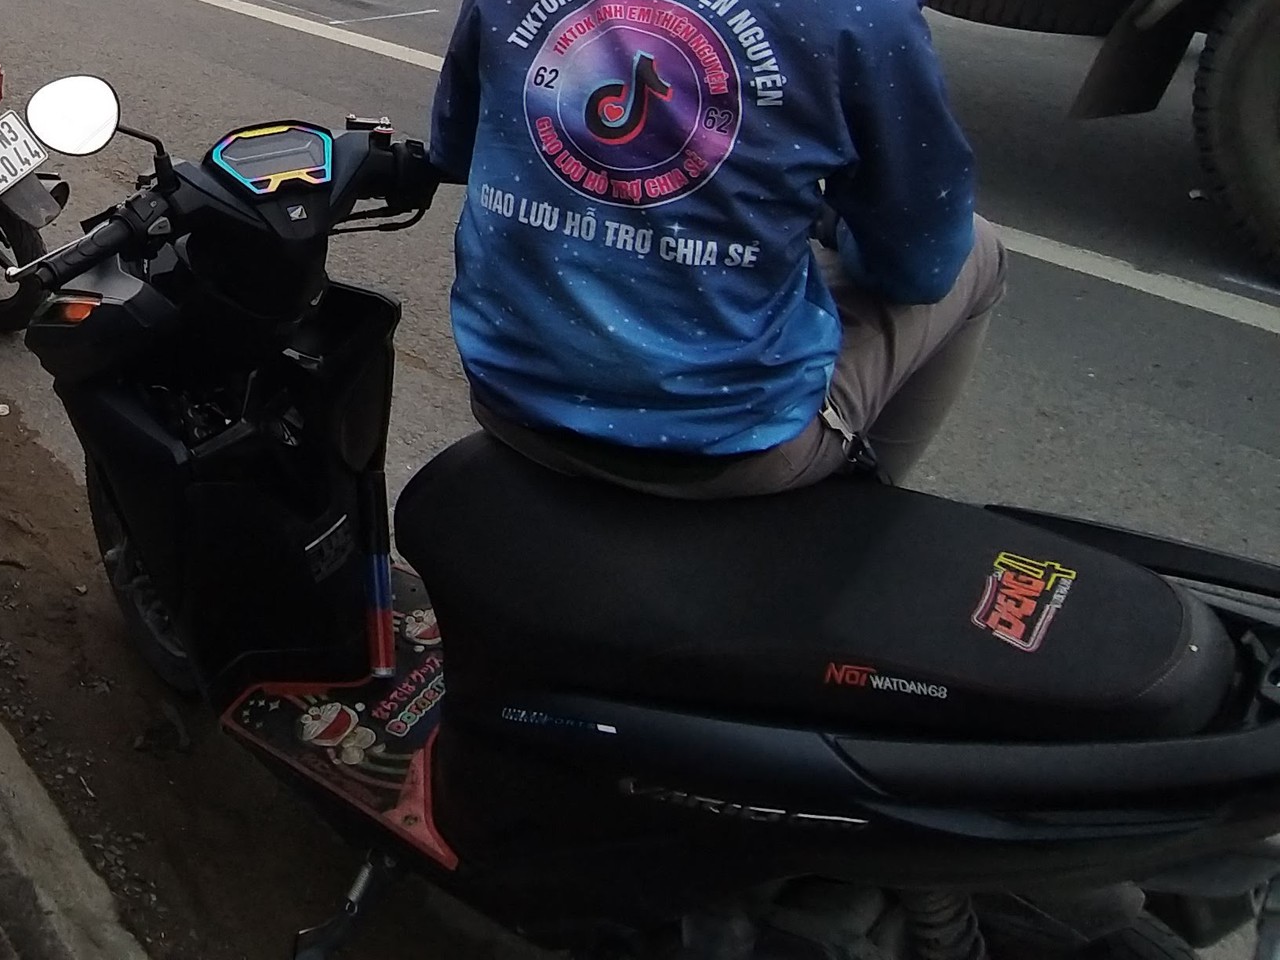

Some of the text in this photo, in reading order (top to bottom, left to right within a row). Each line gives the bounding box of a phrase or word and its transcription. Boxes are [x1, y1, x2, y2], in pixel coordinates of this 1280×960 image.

[532, 65, 560, 91] 62
[553, 4, 730, 96] TIKTOK ANH EM THIỆN NGUYỆN
[726, 8, 788, 107] NGUYỆN
[535, 115, 564, 156] GIAO
[643, 167, 689, 198] CHIA
[702, 106, 734, 136] 62
[480, 183, 515, 218] GIAO
[518, 197, 560, 232] LƯU
[562, 206, 597, 242] HỖ
[604, 220, 654, 259] TRỢ
[659, 236, 718, 266] CHIA
[869, 674, 948, 699] WATDAN68
